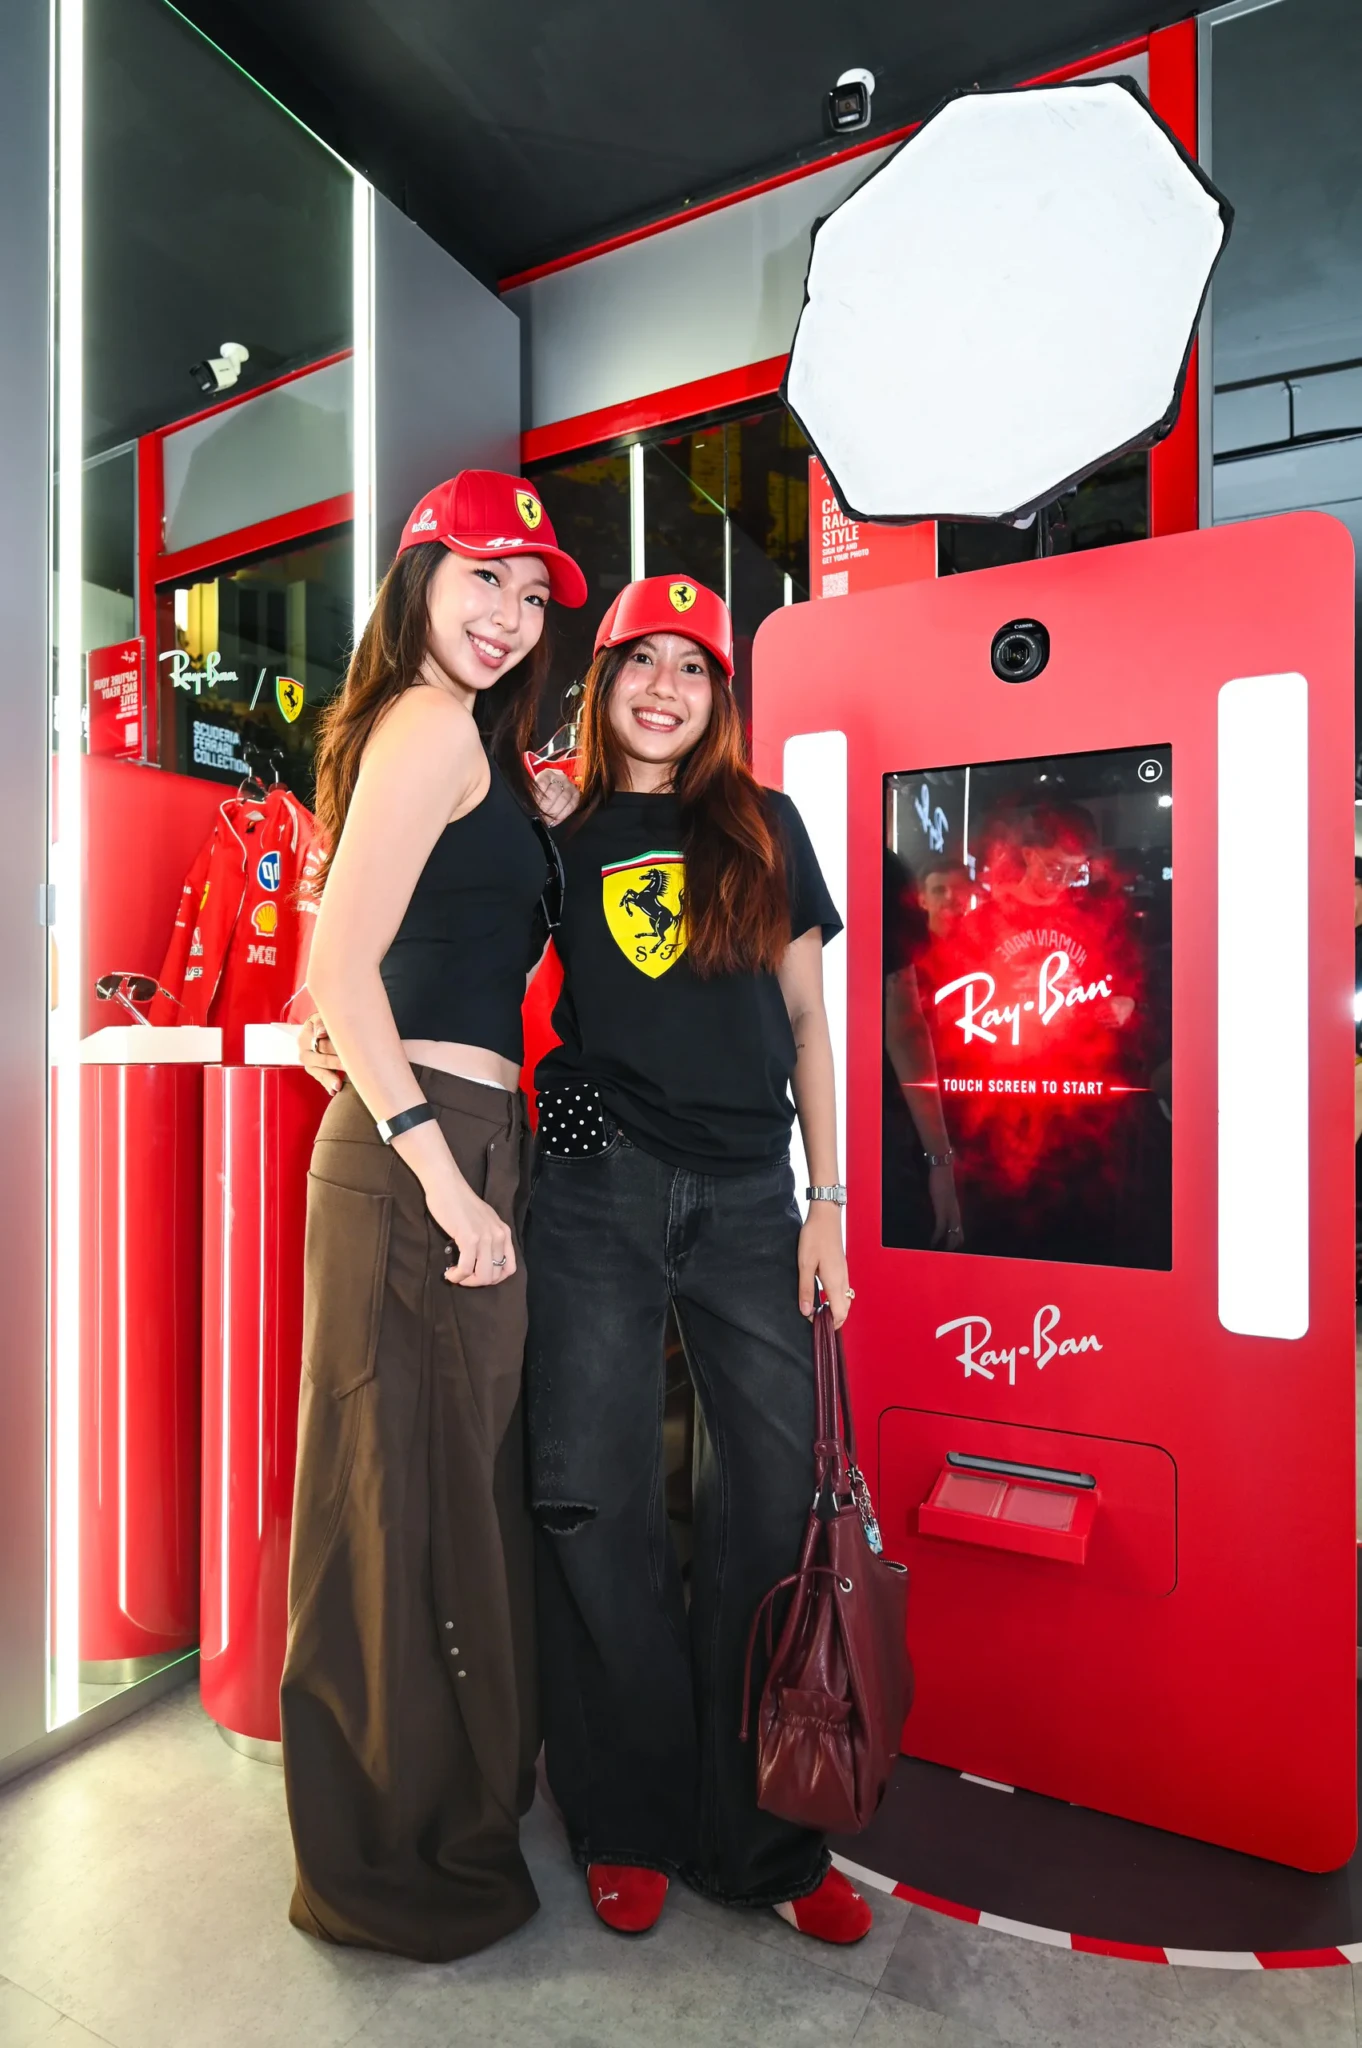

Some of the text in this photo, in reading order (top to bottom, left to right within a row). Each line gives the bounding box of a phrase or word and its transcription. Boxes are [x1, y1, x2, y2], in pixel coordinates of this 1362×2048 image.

[822, 525, 859, 547] STYLE
[822, 542, 858, 556] SIGN UP AND
[822, 548, 870, 565] GET YOUR PHOTO
[193, 721, 241, 745] SCUDERIA
[194, 734, 233, 757] FERRARI
[194, 749, 250, 774] COLLECTION
[943, 1078, 1103, 1095] TOUCH SCREEN TO START
